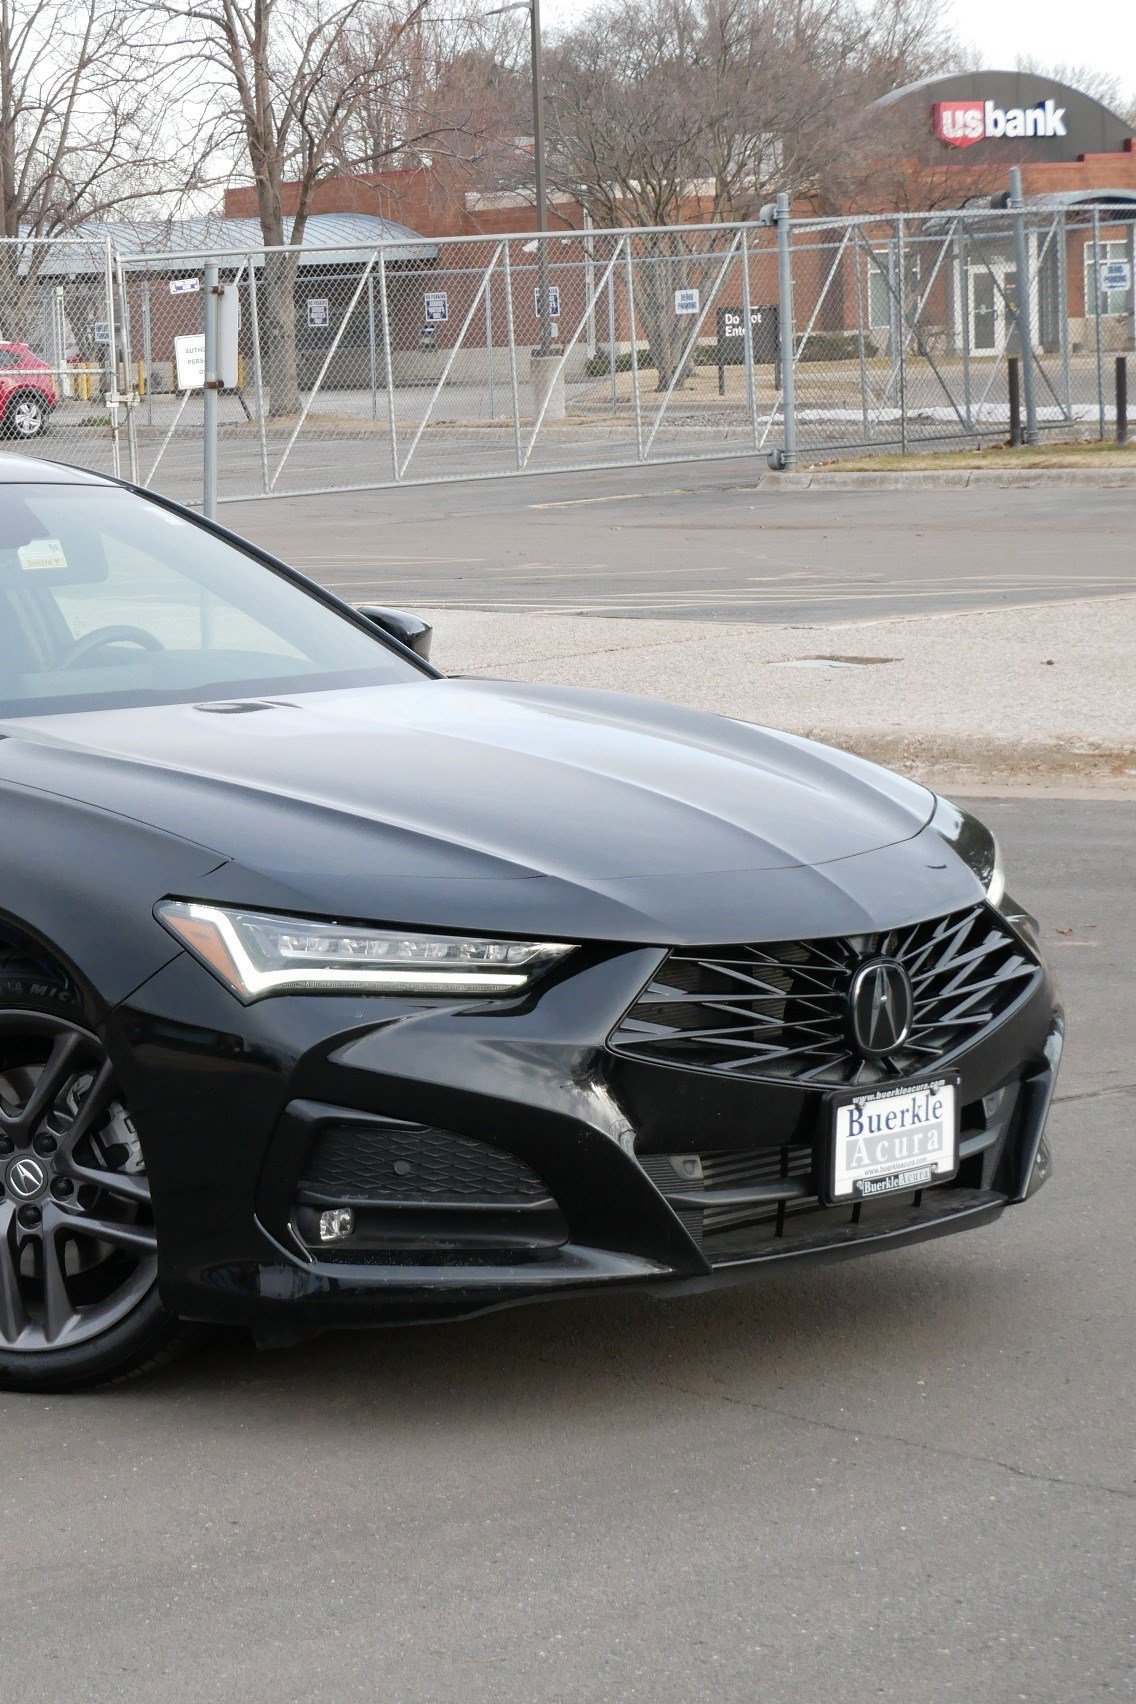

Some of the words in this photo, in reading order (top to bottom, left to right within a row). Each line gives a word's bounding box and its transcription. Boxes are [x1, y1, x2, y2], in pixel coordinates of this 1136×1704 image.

[725, 313, 740, 324] Do
[846, 1094, 943, 1138] Buerkle
[850, 1128, 940, 1168] Acura
